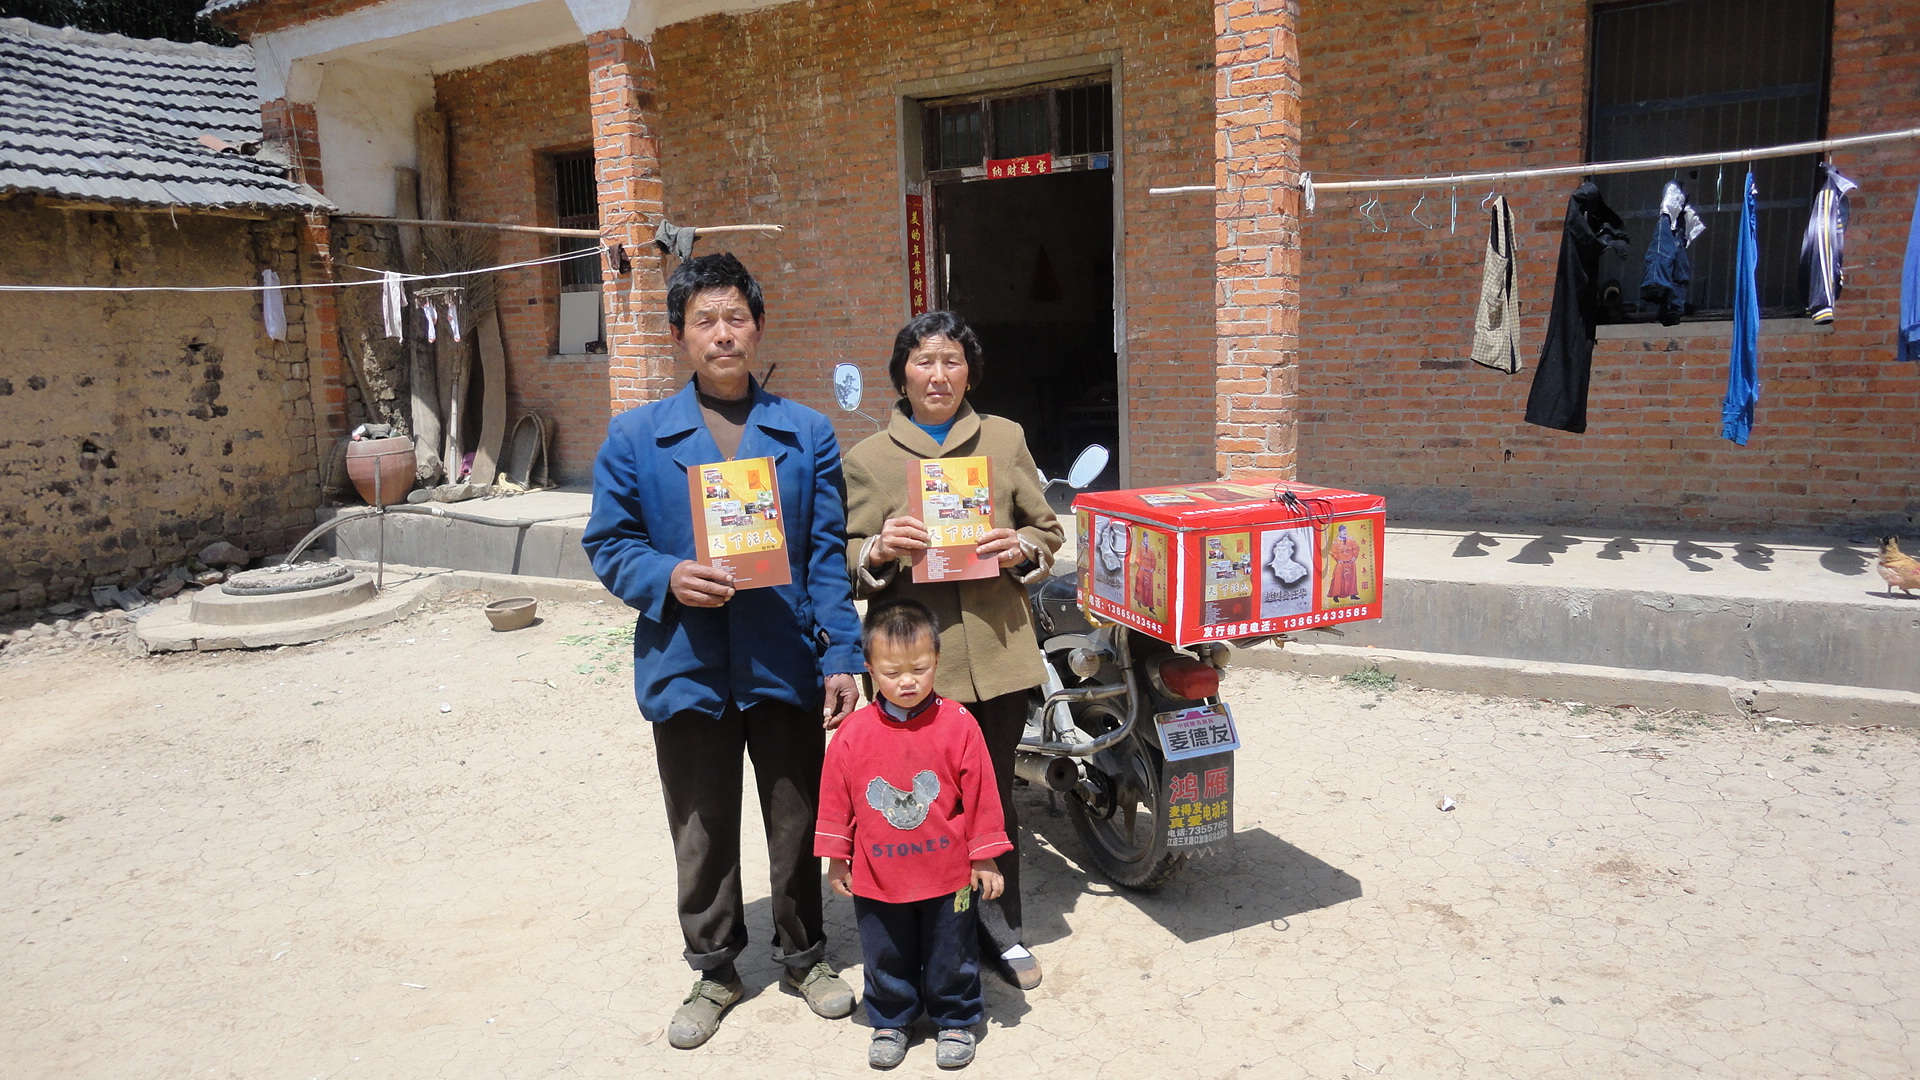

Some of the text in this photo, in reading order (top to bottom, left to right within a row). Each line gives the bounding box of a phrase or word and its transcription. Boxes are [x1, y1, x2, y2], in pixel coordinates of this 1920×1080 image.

[992, 160, 1046, 177] 纳财进宝
[1167, 723, 1230, 751] 麦德发
[1169, 767, 1228, 804] 鸿雁
[1169, 802, 1202, 818] 麦得发
[1203, 799, 1228, 821] 电动车
[872, 836, 950, 857] STONES
